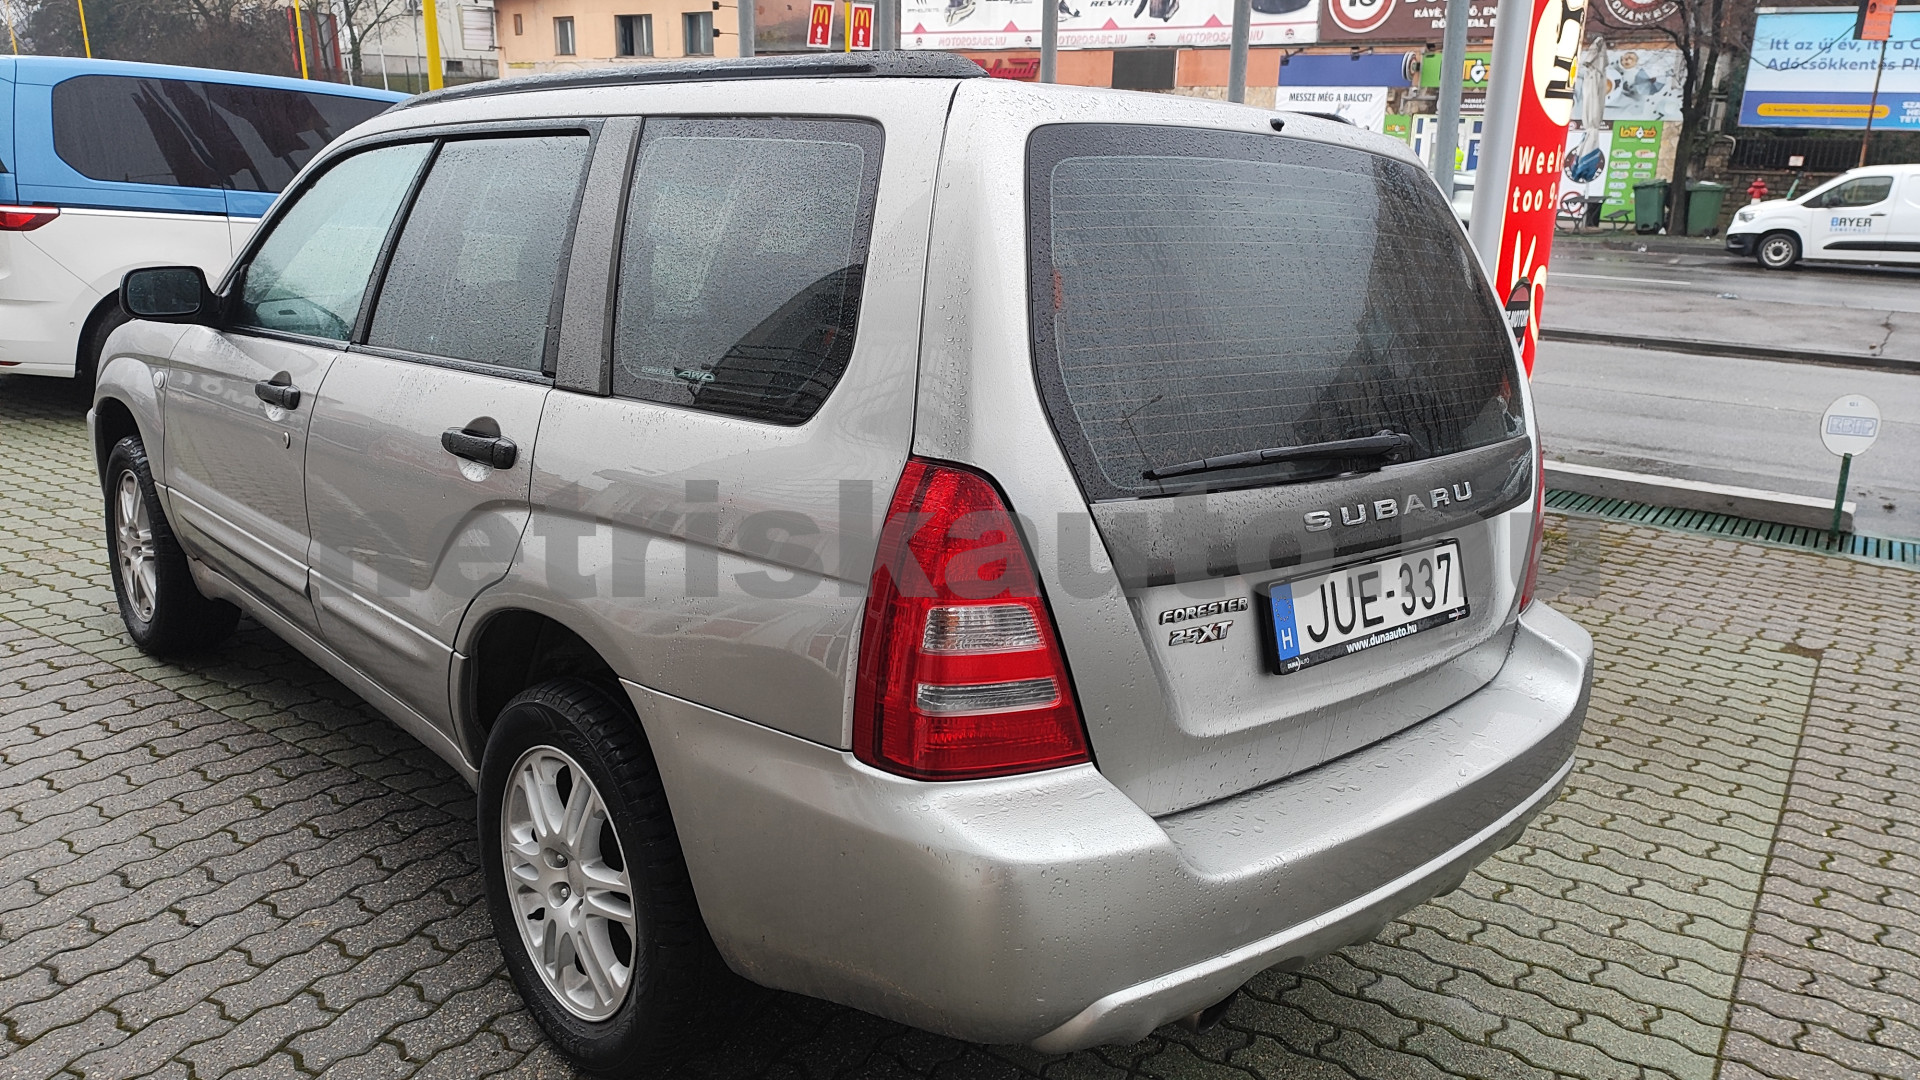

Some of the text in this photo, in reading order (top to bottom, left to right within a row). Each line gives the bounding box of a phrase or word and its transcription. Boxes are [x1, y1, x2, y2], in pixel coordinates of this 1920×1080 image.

[1059, 34, 1128, 45] OTOROSABC.HU
[1769, 38, 1789, 50] Itt
[1794, 41, 1813, 50] az
[1818, 38, 1834, 54] új
[1289, 92, 1316, 102] MESSZE
[1318, 92, 1334, 102] MÉG
[1344, 93, 1373, 102] BALCSI?
[1512, 185, 1543, 213] too
[1831, 217, 1872, 227] BAYER
[1303, 481, 1473, 532] SUBARU
[1160, 597, 1248, 625] FORESTER
[1281, 553, 1452, 650] H JUE-337
[1346, 622, 1418, 653] www.dunaauto.hu
